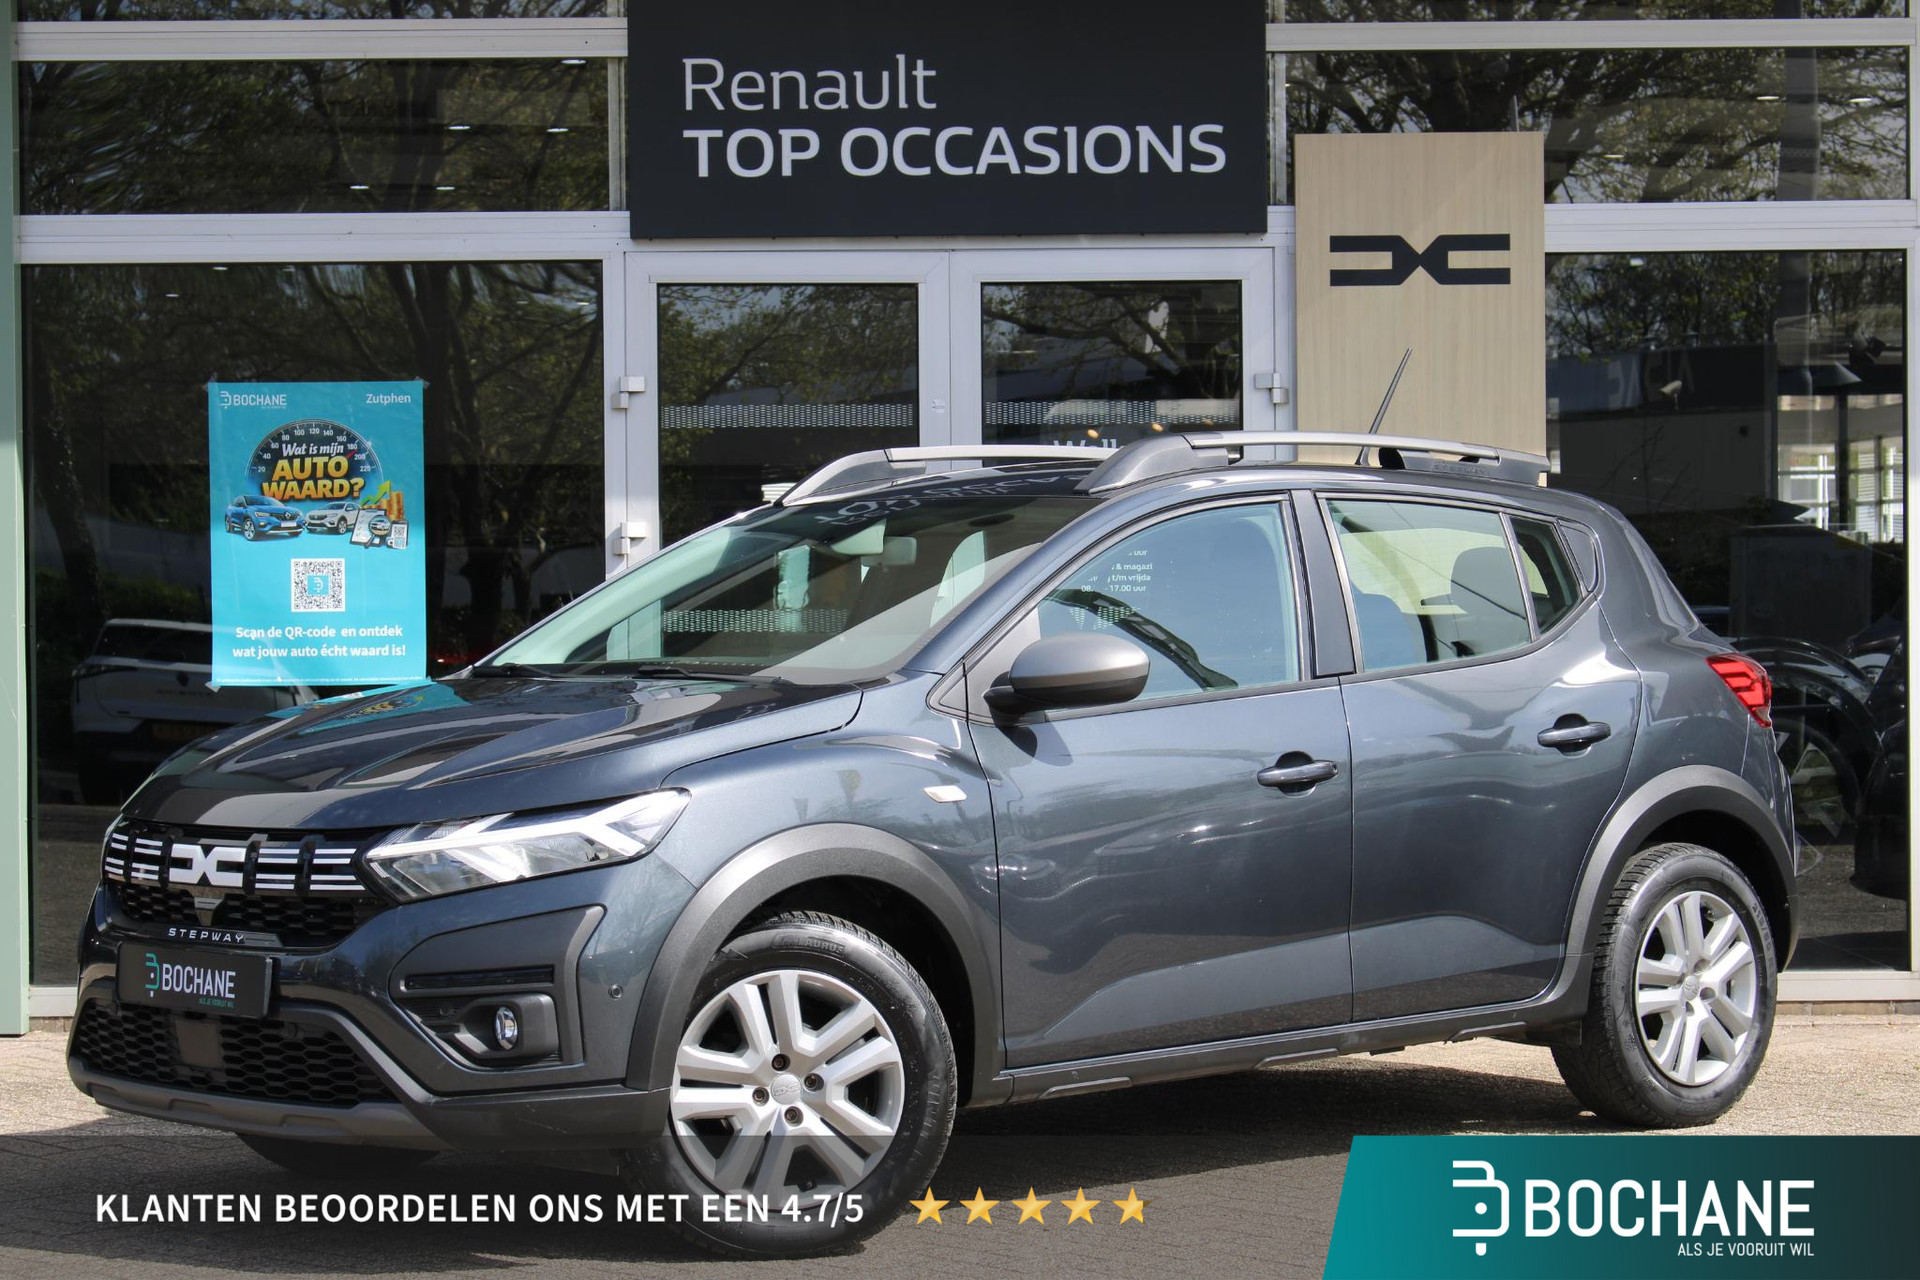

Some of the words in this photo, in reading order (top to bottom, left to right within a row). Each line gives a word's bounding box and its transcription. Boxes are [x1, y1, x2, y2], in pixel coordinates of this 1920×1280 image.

[682, 54, 937, 111] Renault
[682, 128, 820, 178] TOP
[840, 124, 1226, 176] OCCASIONS
[233, 394, 287, 406] BOCHANE
[365, 393, 411, 406] Zutphen
[282, 442, 307, 457] Wat
[309, 442, 318, 455] is
[320, 442, 344, 457] mijn
[271, 455, 349, 482] AUTO
[261, 477, 365, 500] WAARD?
[235, 626, 265, 638] Scan
[267, 626, 282, 638] de
[284, 626, 336, 639] QR-code
[341, 628, 356, 638] en
[359, 625, 404, 638] ontdek
[232, 646, 256, 658] wat
[257, 646, 288, 660] jouw
[290, 647, 318, 658] auto
[320, 643, 348, 657] écht
[350, 645, 389, 657] waard
[391, 644, 406, 656] is!
[168, 927, 244, 943] STEPWAY
[161, 963, 236, 999] BOCHANE
